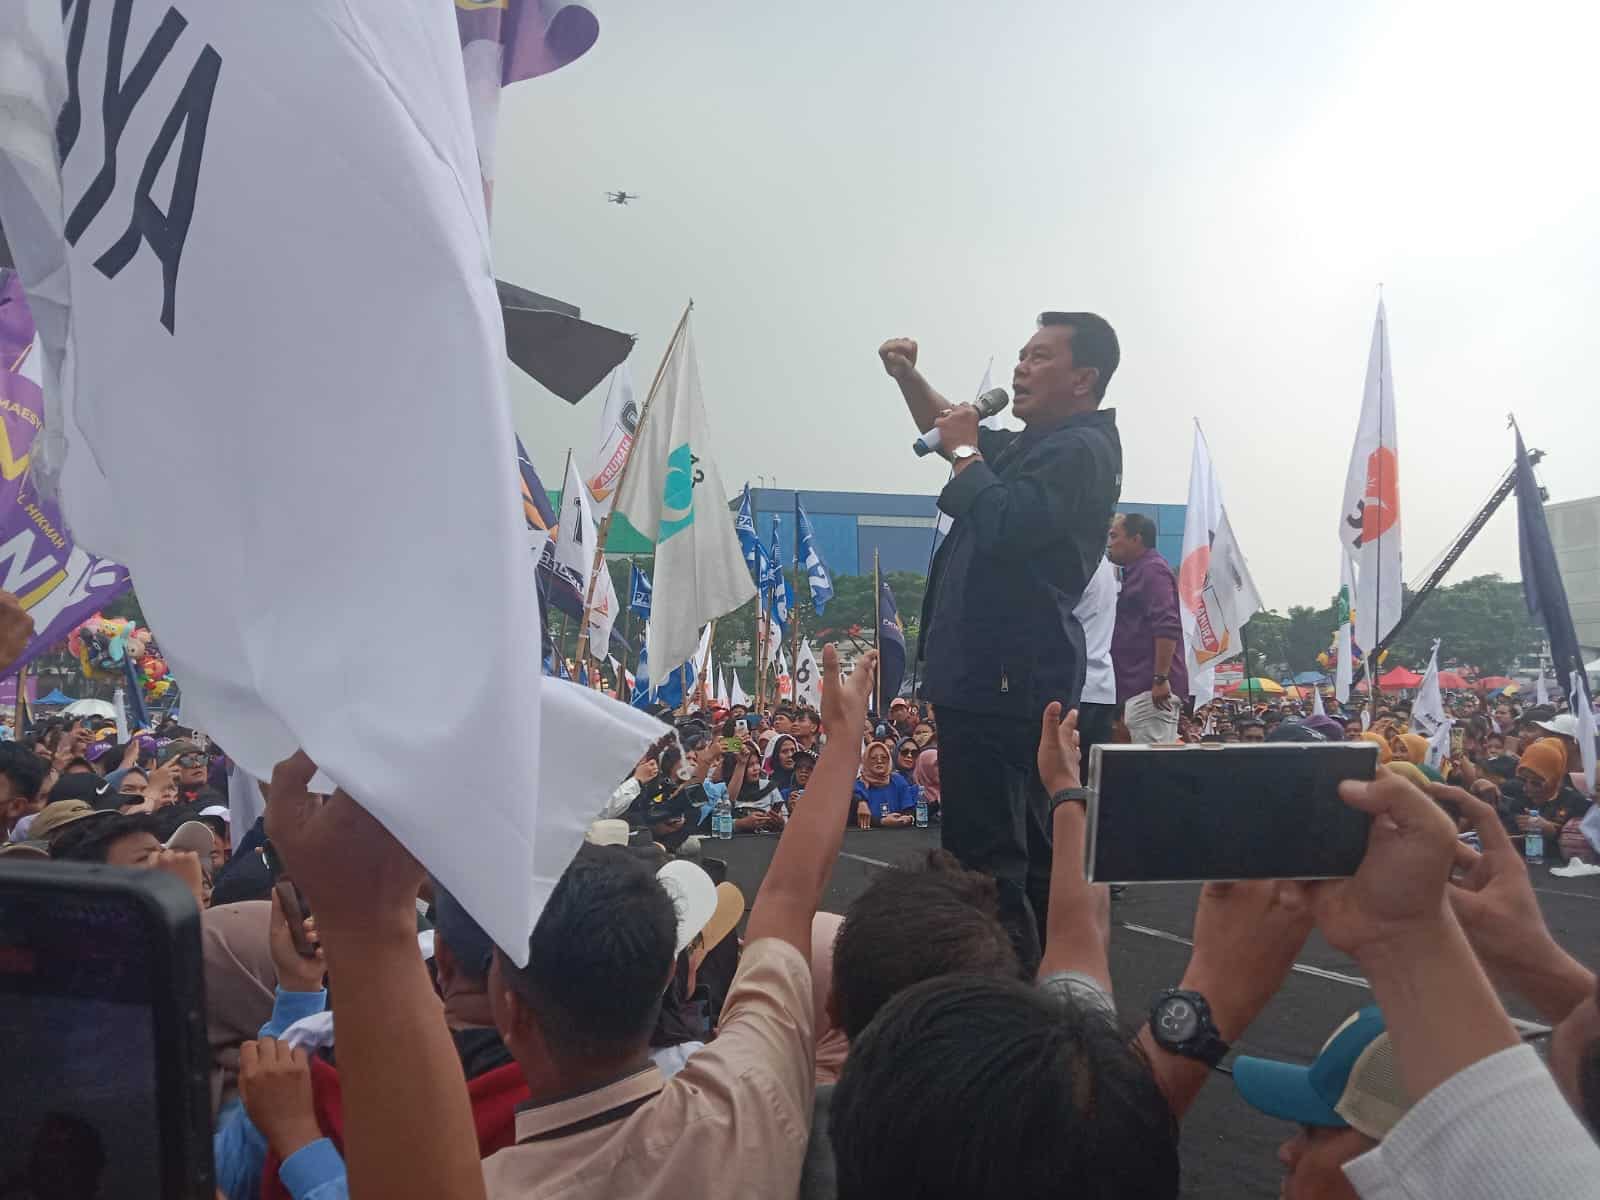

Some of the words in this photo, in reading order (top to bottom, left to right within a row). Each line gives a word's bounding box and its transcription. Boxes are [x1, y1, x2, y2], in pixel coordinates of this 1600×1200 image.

[24, 503, 66, 550] HIKMAH
[736, 515, 753, 527] PA
[634, 592, 650, 604] PA
